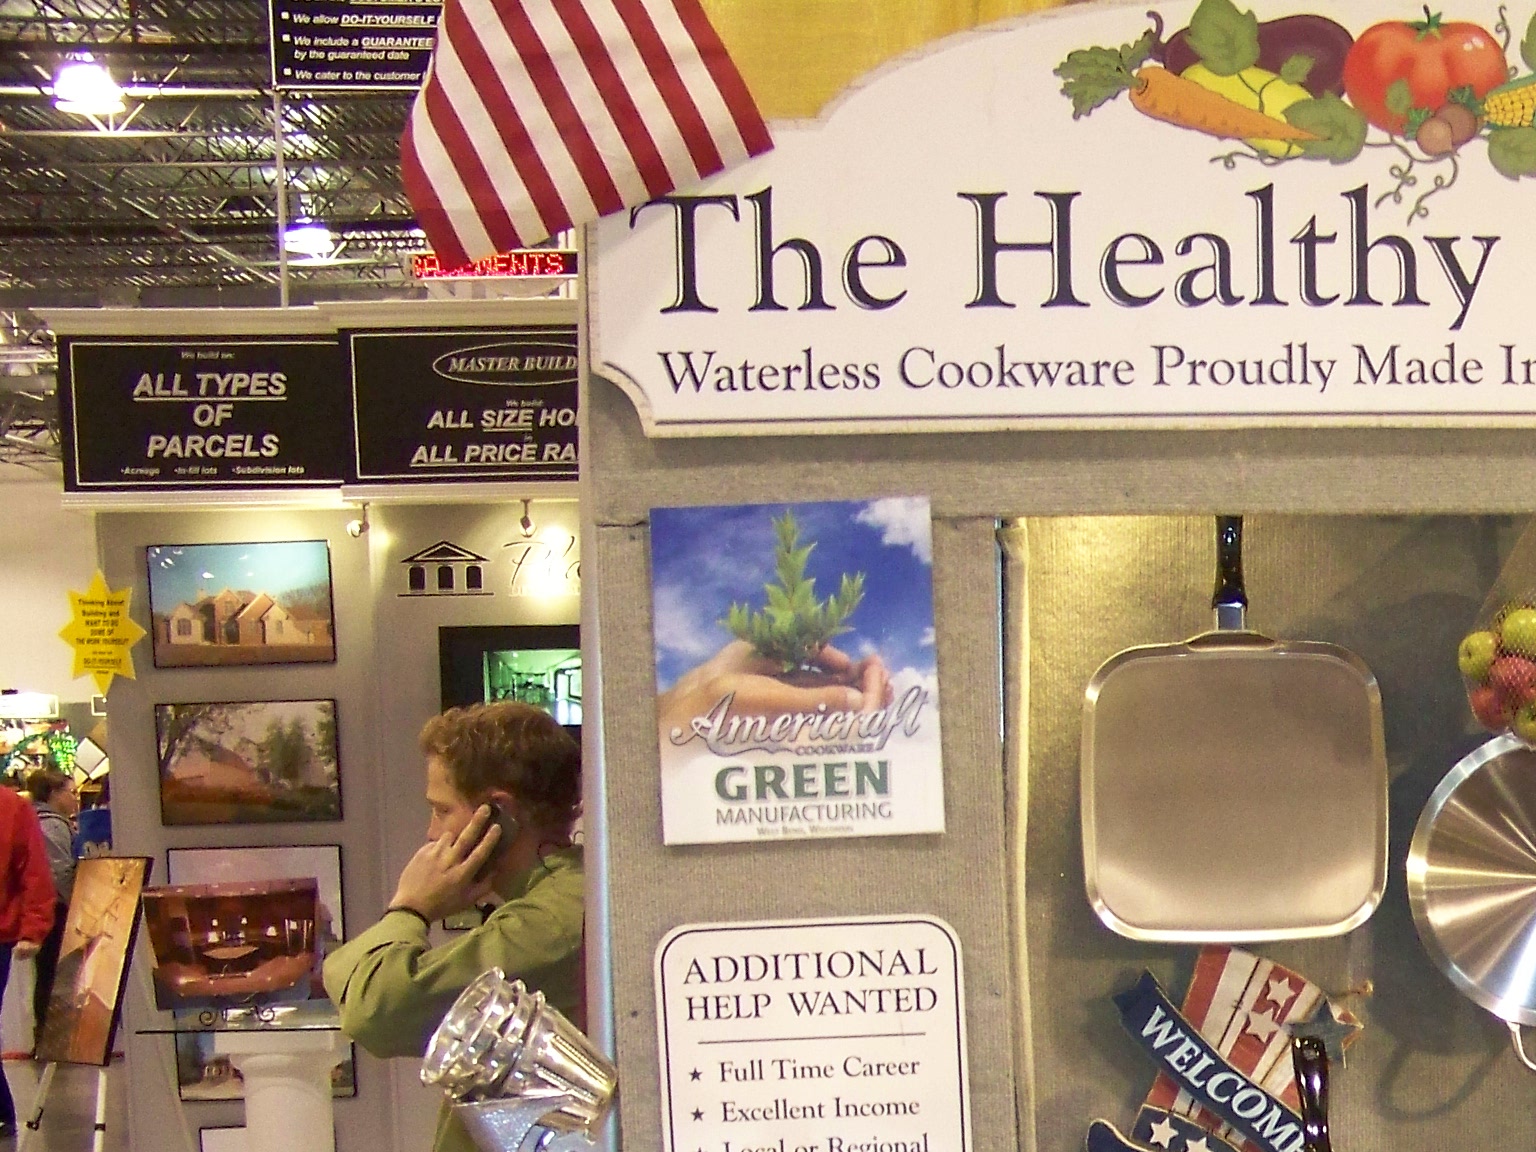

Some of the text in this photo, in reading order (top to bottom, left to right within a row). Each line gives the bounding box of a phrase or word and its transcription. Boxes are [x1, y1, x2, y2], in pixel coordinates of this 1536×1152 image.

[314, 36, 349, 46] include
[294, 50, 410, 62] by the guaranteed date
[295, 70, 420, 81] We cater to the customer
[628, 184, 909, 314] The
[957, 182, 1501, 330] Healthy
[449, 358, 520, 373] MASTER
[657, 349, 881, 393] Waterless
[898, 343, 1135, 391] Cookware
[1151, 342, 1335, 393] Proudly
[1354, 344, 1484, 387] Made
[133, 372, 288, 397] ALL TYPES
[193, 403, 234, 428] OF
[427, 409, 474, 429] ALL
[481, 409, 535, 428] SIZE
[147, 434, 280, 459] PARCELS
[411, 445, 458, 464] ALL
[464, 444, 538, 463] PRICE
[669, 685, 929, 757] Americraft
[795, 743, 876, 756] COOKWARE
[714, 760, 889, 801] GREEN
[716, 802, 893, 825] MANUFACTURING
[683, 948, 938, 985] ADDITIONAL
[686, 986, 938, 1021] HELP WANTED
[718, 1055, 921, 1082] Full Time Career
[721, 1096, 920, 1123] Excellent Income
